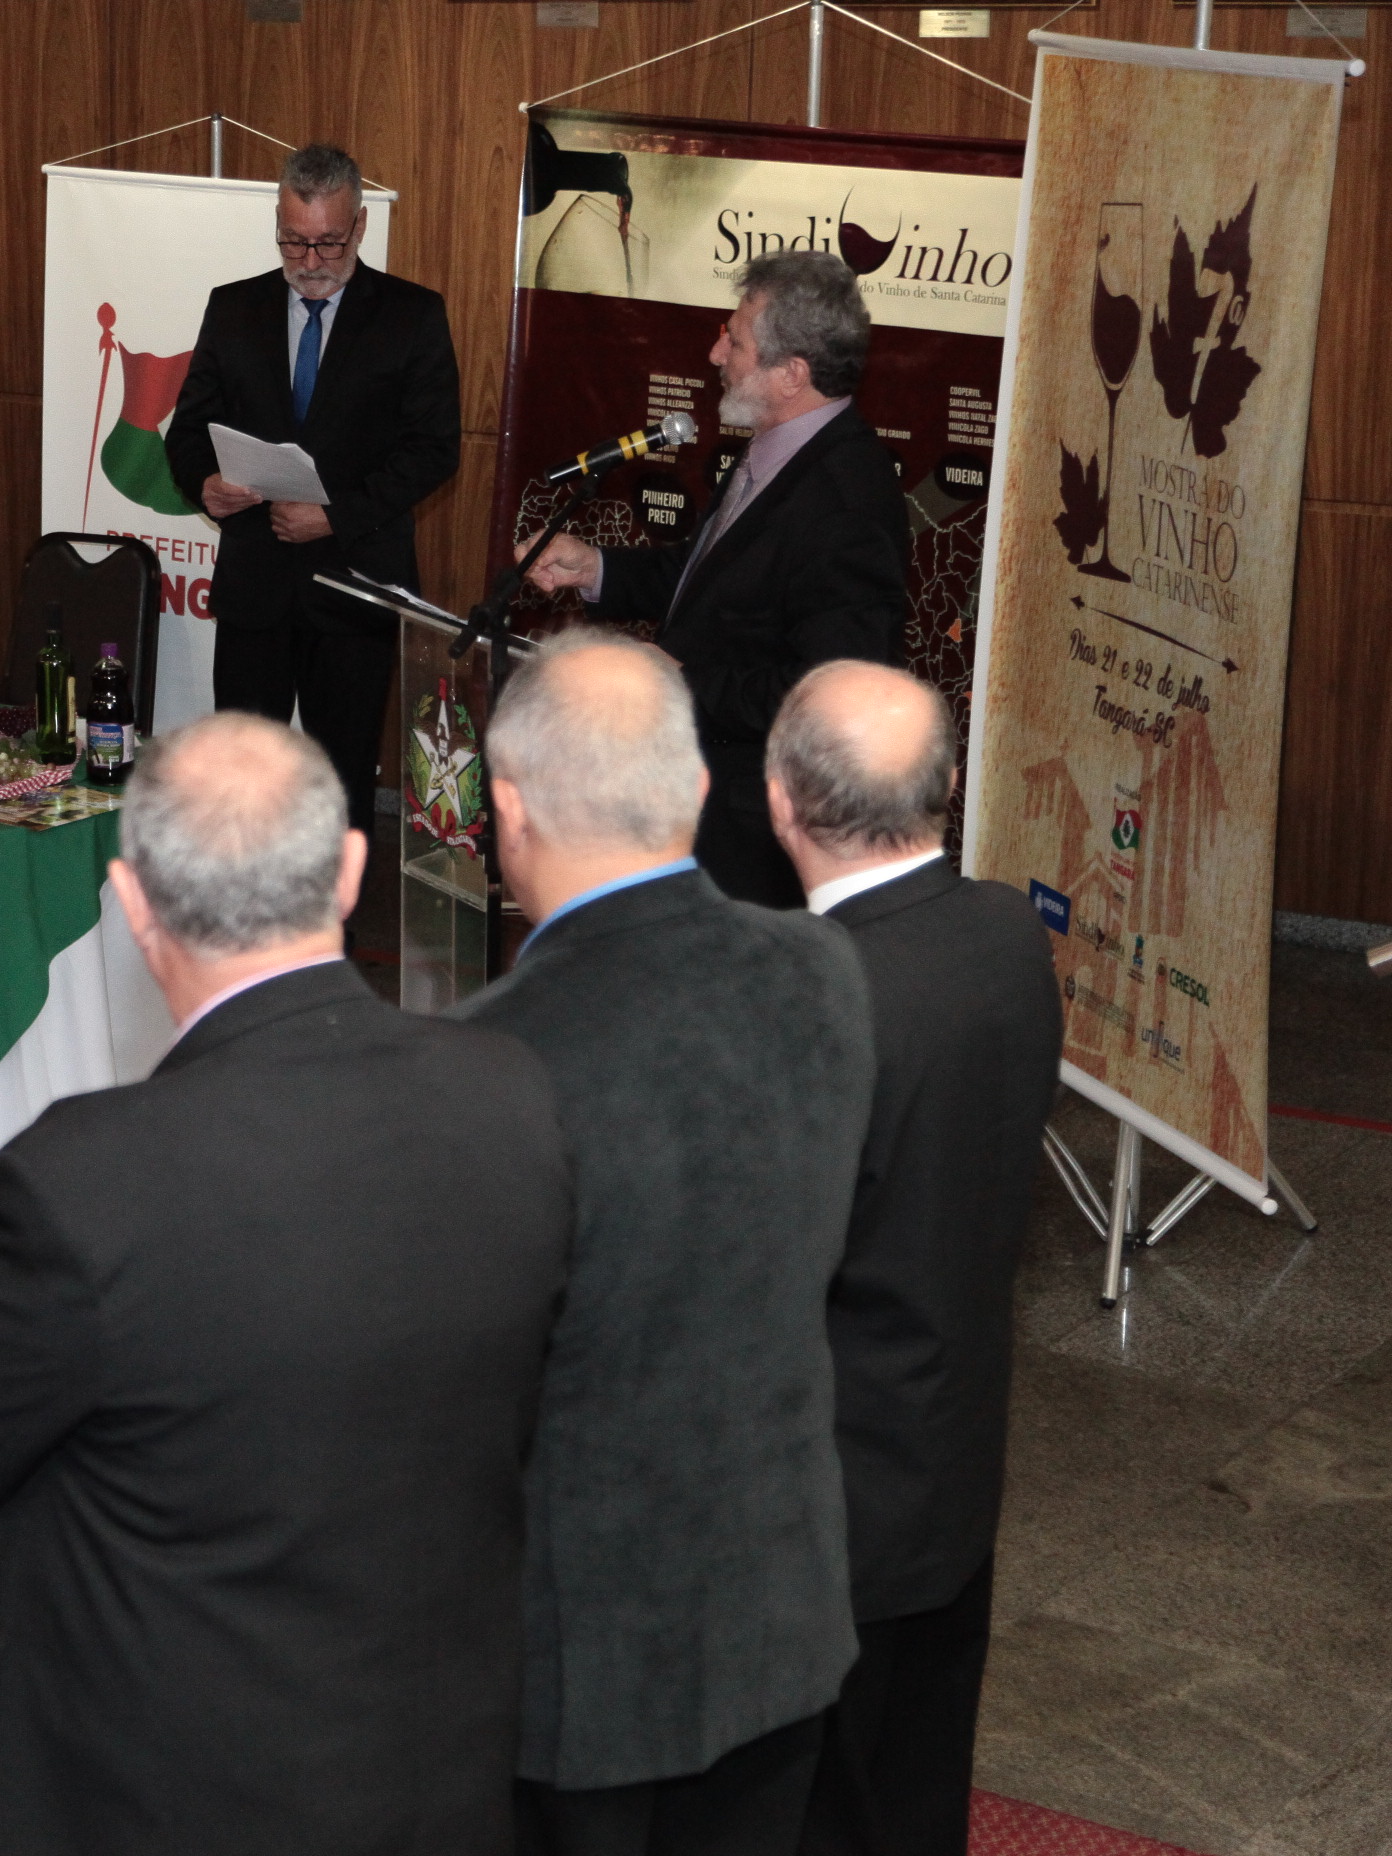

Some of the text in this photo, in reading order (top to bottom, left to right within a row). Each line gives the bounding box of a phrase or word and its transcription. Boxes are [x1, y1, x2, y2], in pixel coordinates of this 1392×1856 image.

[877, 282, 911, 297] Vinho
[913, 285, 927, 298] de
[930, 287, 961, 302] Santa
[963, 290, 1007, 306] Catarina
[945, 466, 984, 486] VIDEIRA
[1139, 455, 1245, 519] MOSTRA DO
[642, 489, 684, 509] PINHEIRO
[648, 508, 676, 526] PRETO
[1138, 493, 1238, 583] VINHO
[1132, 557, 1240, 625] CATARINENSE
[1069, 628, 1210, 715] Dias 21 e 22 de julho
[1169, 967, 1210, 1008] CRESOL
